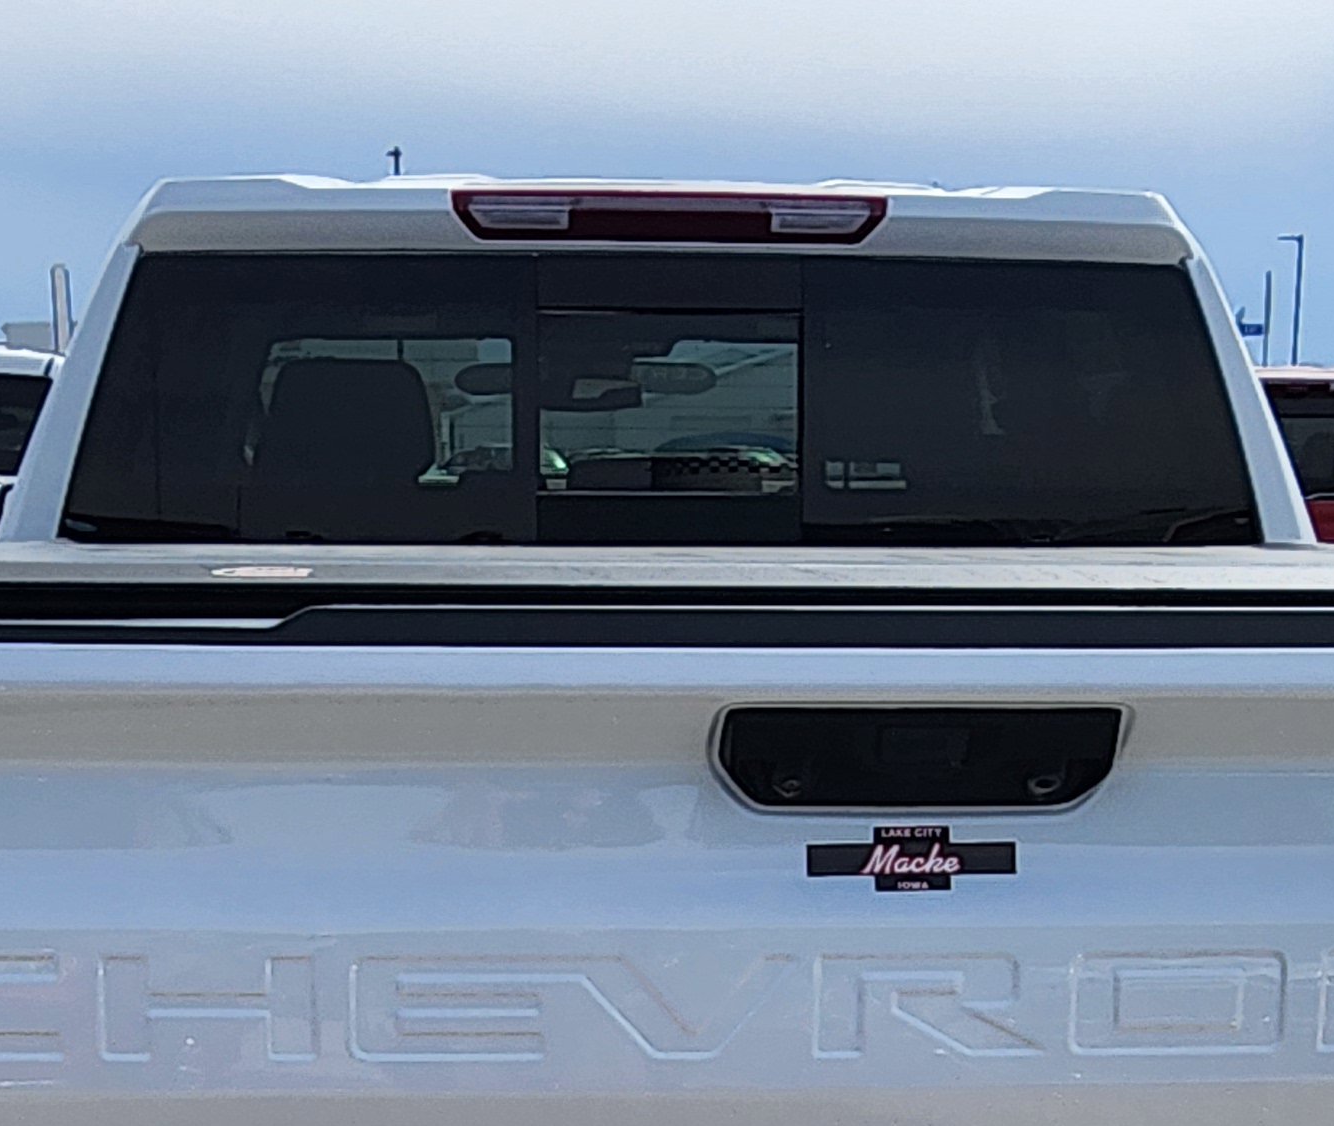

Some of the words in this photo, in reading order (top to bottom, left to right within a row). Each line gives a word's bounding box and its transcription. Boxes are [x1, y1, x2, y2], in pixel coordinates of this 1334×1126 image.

[880, 828, 911, 838] LAKE
[913, 827, 942, 838] CITY
[860, 842, 961, 875] Macke
[897, 880, 929, 890] IOWA
